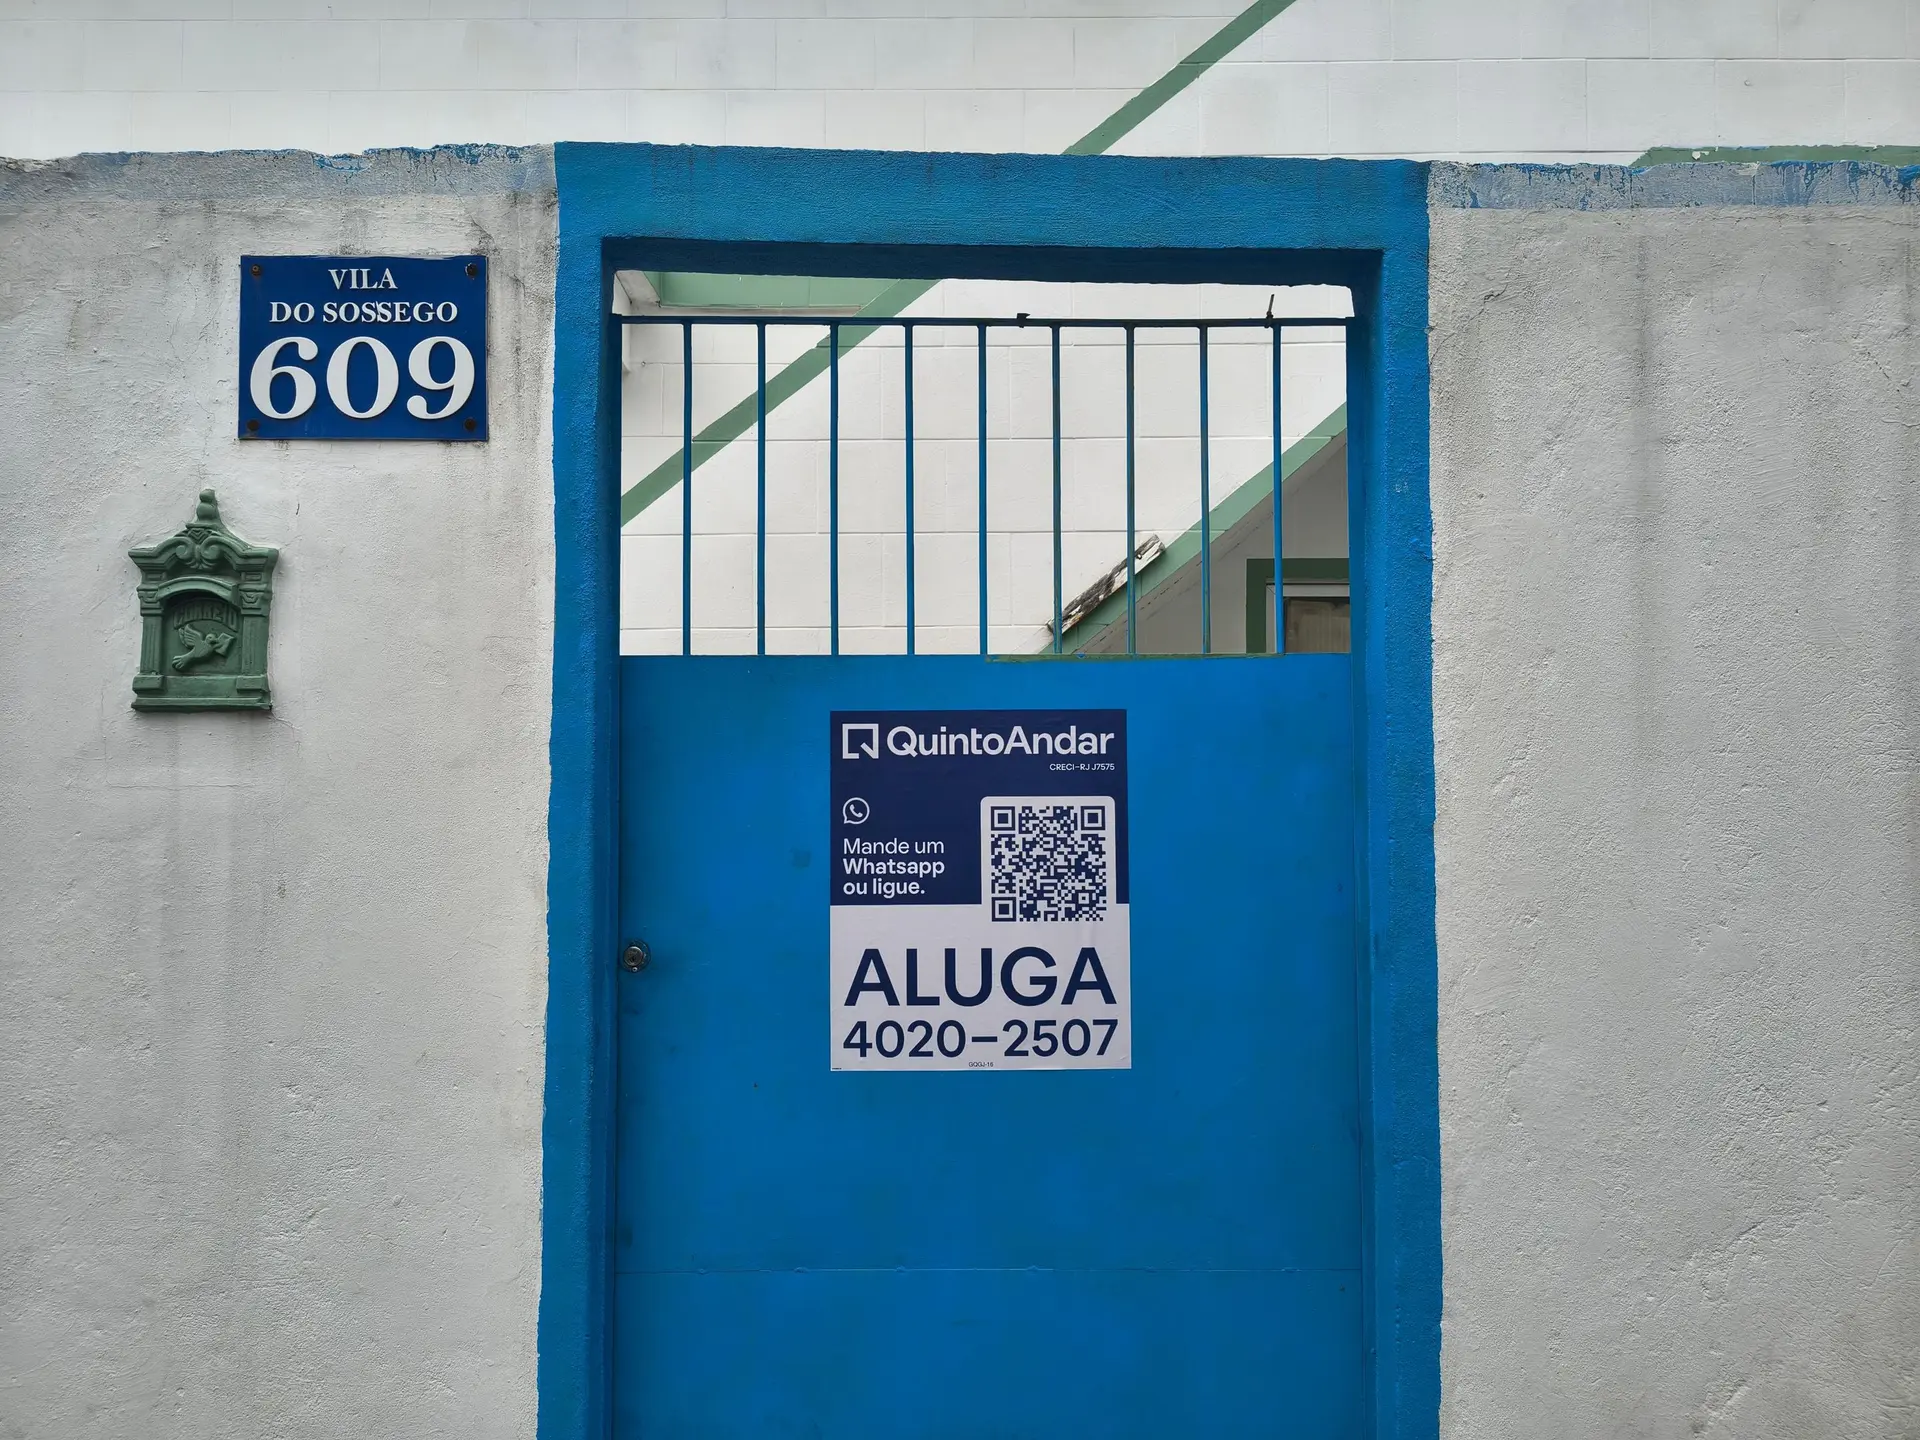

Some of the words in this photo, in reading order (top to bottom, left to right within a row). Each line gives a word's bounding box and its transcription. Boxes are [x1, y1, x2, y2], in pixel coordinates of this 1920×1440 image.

[328, 268, 398, 290] VILA
[269, 301, 315, 323] DO
[323, 301, 458, 323] SOSSEGO
[250, 336, 475, 420] 609
[886, 725, 1115, 757] QuintoAndar
[1049, 763, 1090, 771] CRECI-RJ
[1091, 763, 1115, 771] J7575
[843, 838, 909, 855] Mande
[915, 840, 944, 854] um
[843, 858, 945, 878] Whatsapp
[843, 881, 867, 895] ou
[872, 878, 925, 899] ligue.
[843, 946, 1117, 1007] ALUGA
[843, 1018, 1118, 1058] 4020-2507
